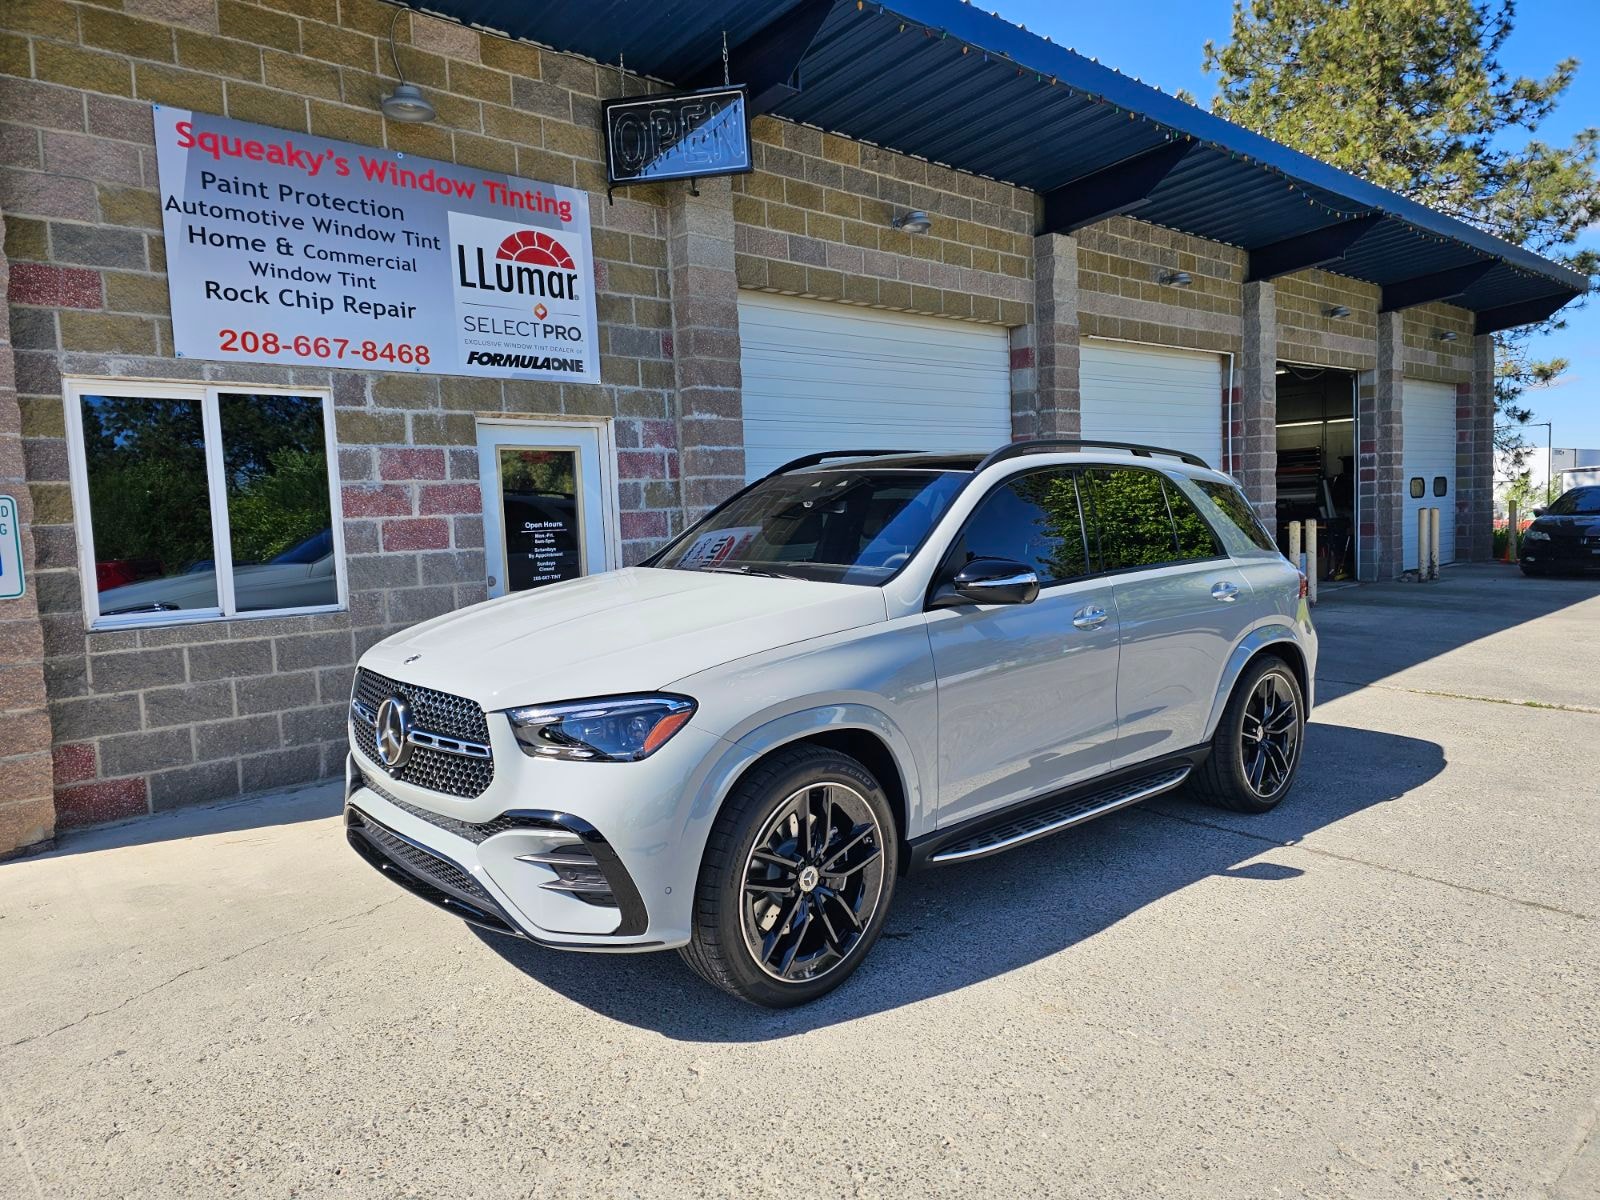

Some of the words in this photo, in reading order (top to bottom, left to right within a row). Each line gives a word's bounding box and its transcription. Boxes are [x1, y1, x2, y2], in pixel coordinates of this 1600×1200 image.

[613, 98, 744, 171] OPEN
[175, 121, 350, 176] Squeaky's
[358, 155, 475, 199] Window
[483, 179, 572, 222] Tinting
[201, 170, 269, 200] Paint
[279, 183, 404, 221] Protection
[165, 195, 305, 230] Automotive
[312, 216, 395, 243] Window
[401, 230, 441, 250] Tint
[188, 225, 266, 252] Home
[276, 237, 294, 256] &
[303, 244, 417, 272] Commercial
[457, 244, 578, 300] LLumar
[248, 260, 331, 284] Window
[337, 271, 377, 290] Tint
[205, 280, 270, 304] Rock
[279, 288, 334, 314] Chip
[343, 295, 417, 319] Repair
[219, 329, 431, 365] 208-667-8468
[464, 338, 502, 348] EXCLUSIVE
[504, 342, 533, 351] WINDOW
[525, 521, 543, 530] Open
